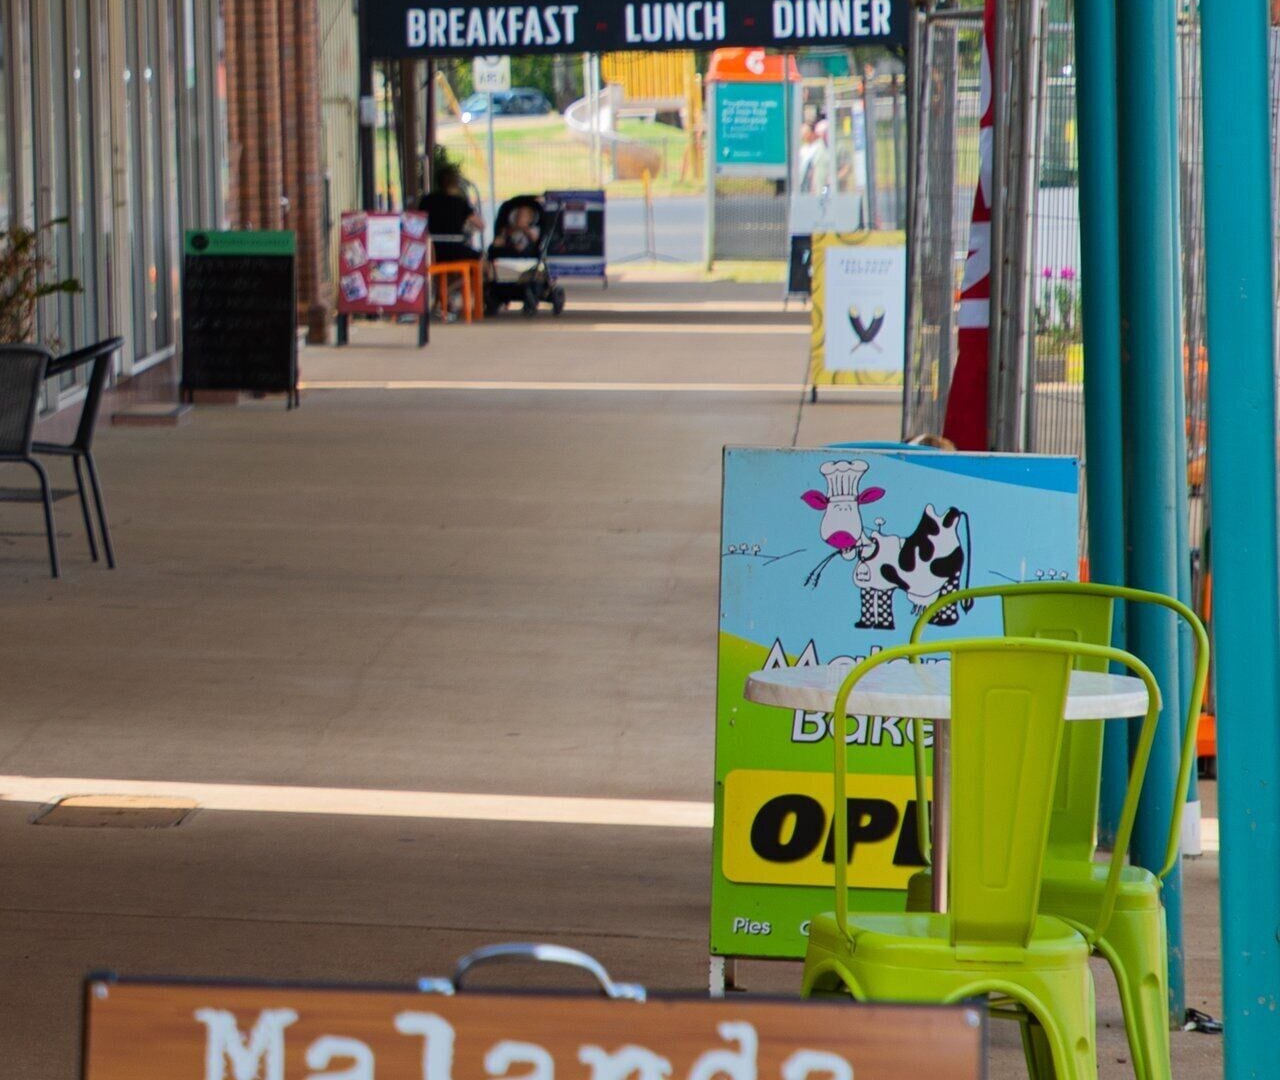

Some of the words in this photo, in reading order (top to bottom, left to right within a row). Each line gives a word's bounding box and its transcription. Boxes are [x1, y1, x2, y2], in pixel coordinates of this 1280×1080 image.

[406, 5, 579, 48] BREAKFAST
[625, 1, 726, 43] LUNCH
[733, 917, 772, 935] Pies
